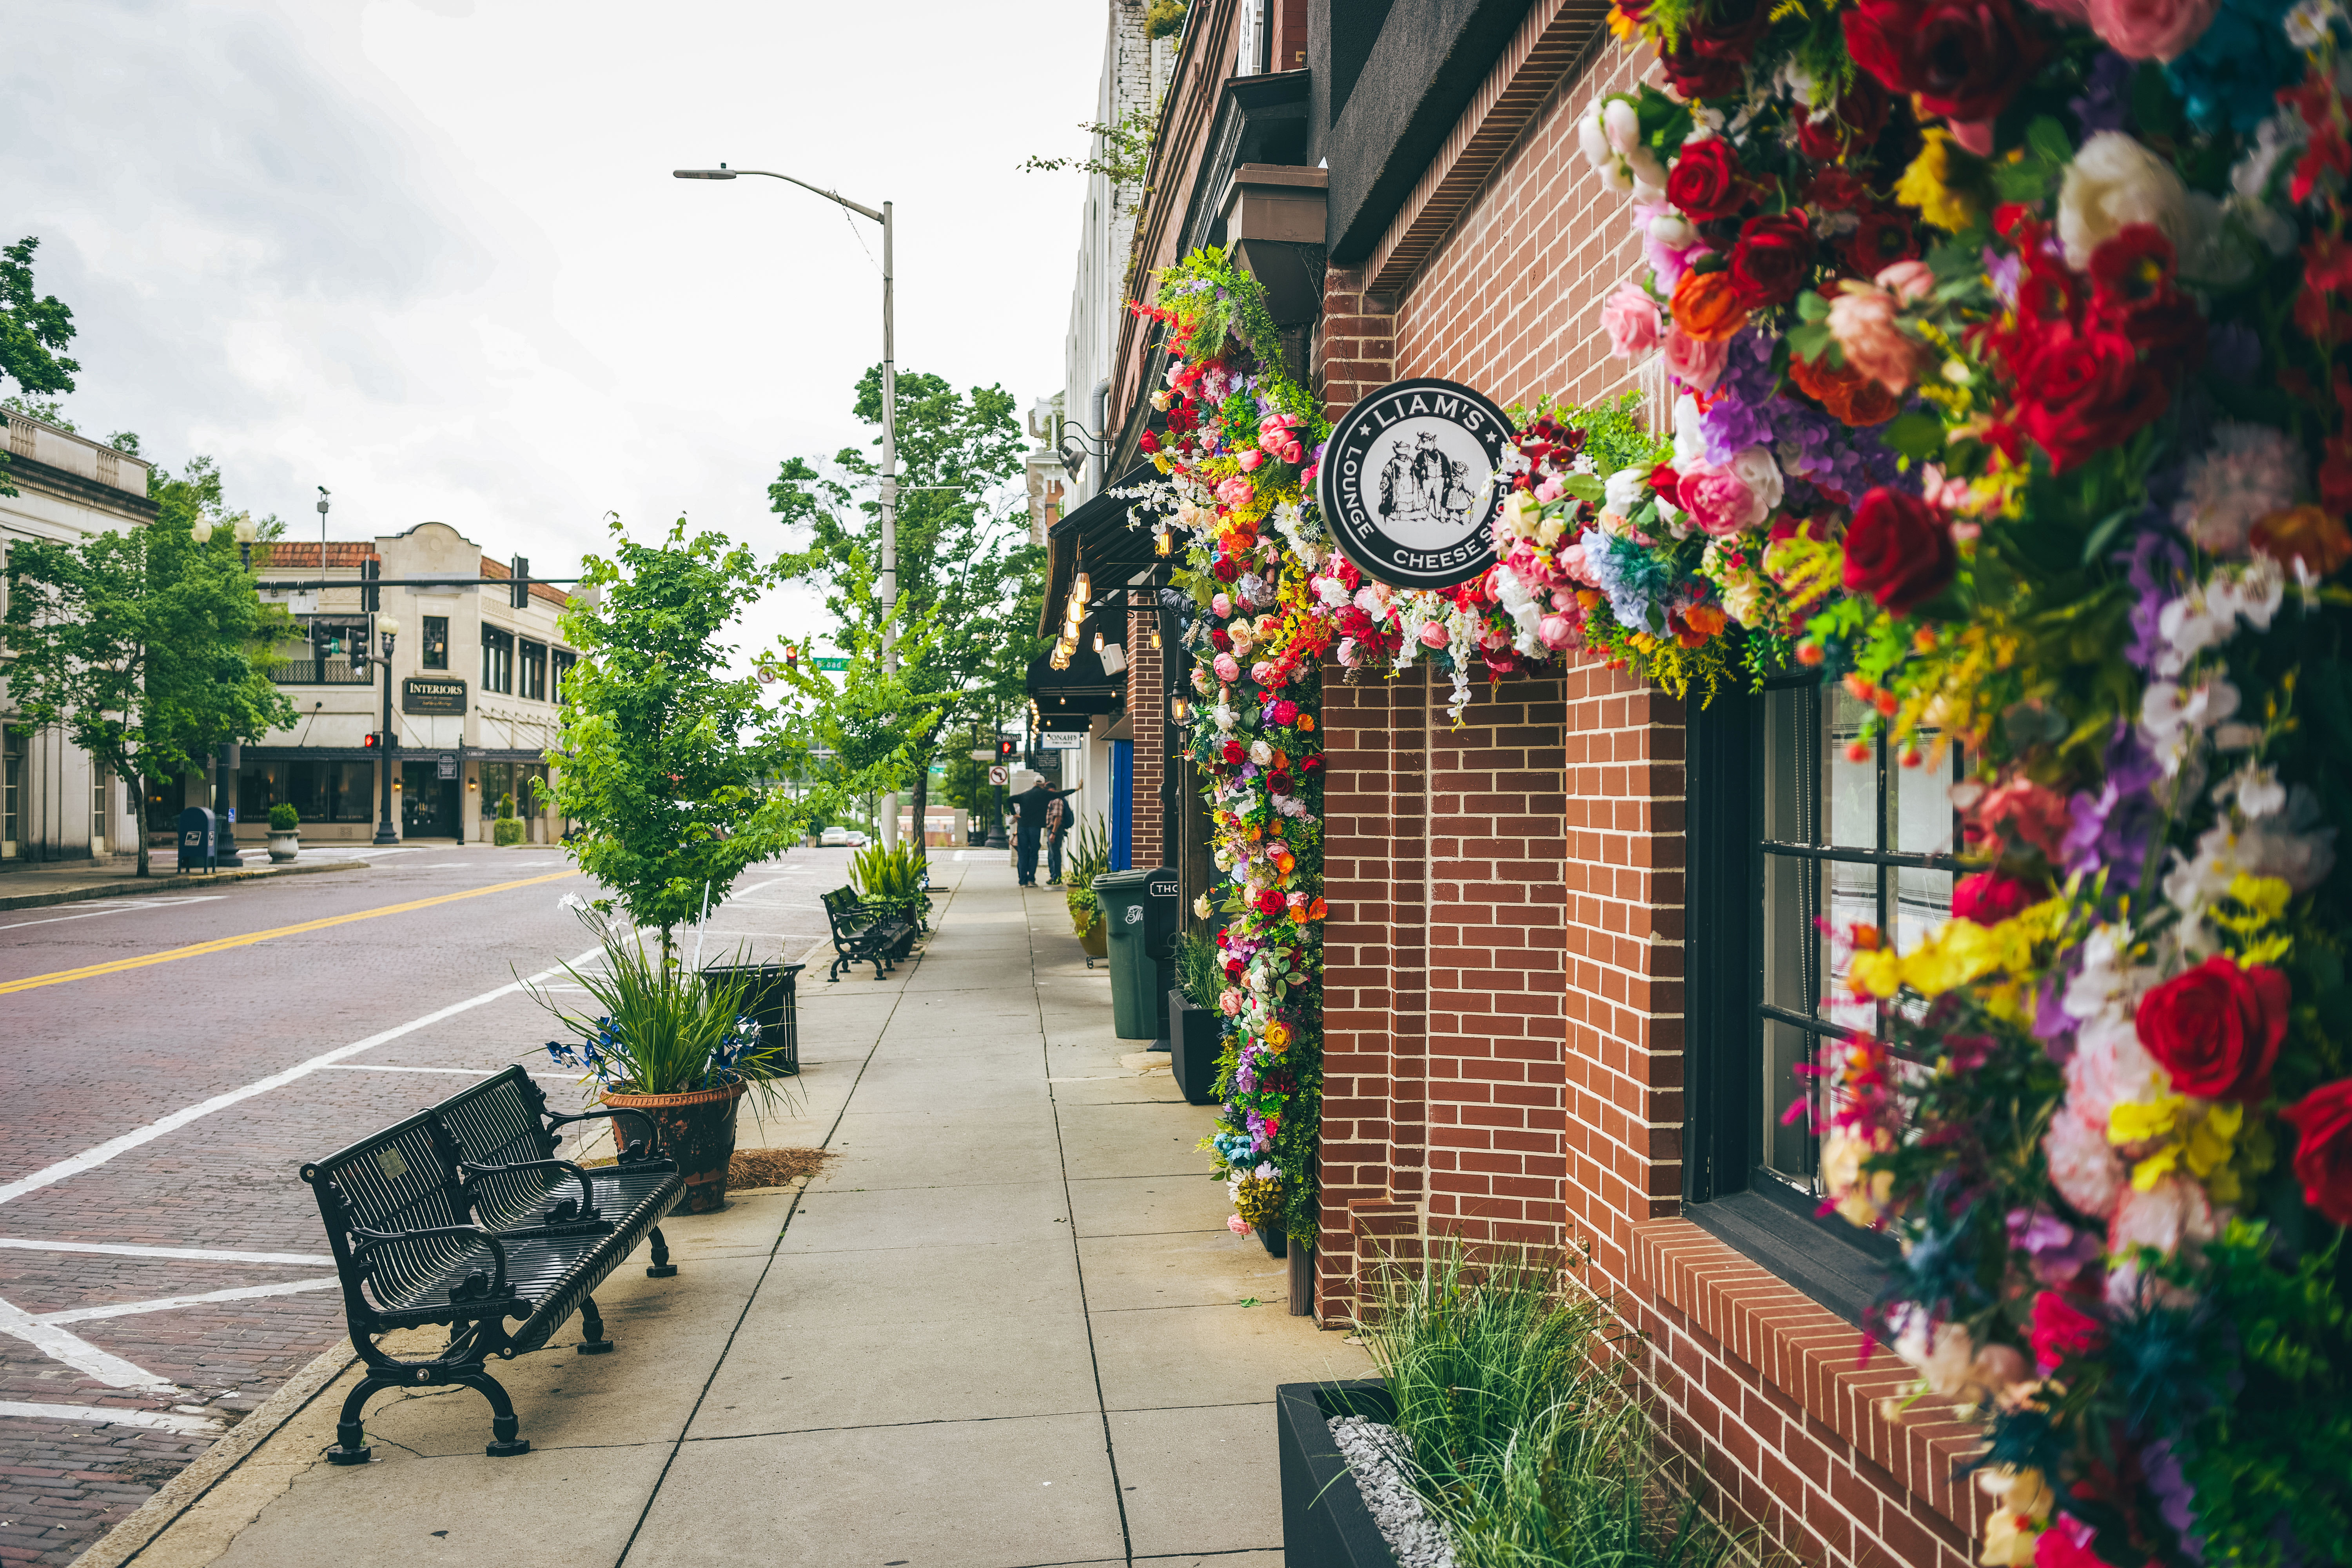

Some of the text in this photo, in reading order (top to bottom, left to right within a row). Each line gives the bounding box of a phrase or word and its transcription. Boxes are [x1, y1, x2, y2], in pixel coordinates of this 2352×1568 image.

[1373, 394, 1485, 431] LIAM'S
[1343, 446, 1375, 539] LOUNGE
[1394, 539, 1481, 569] CHEESE
[817, 660, 841, 668] Boad
[410, 682, 463, 695] INTERIORS
